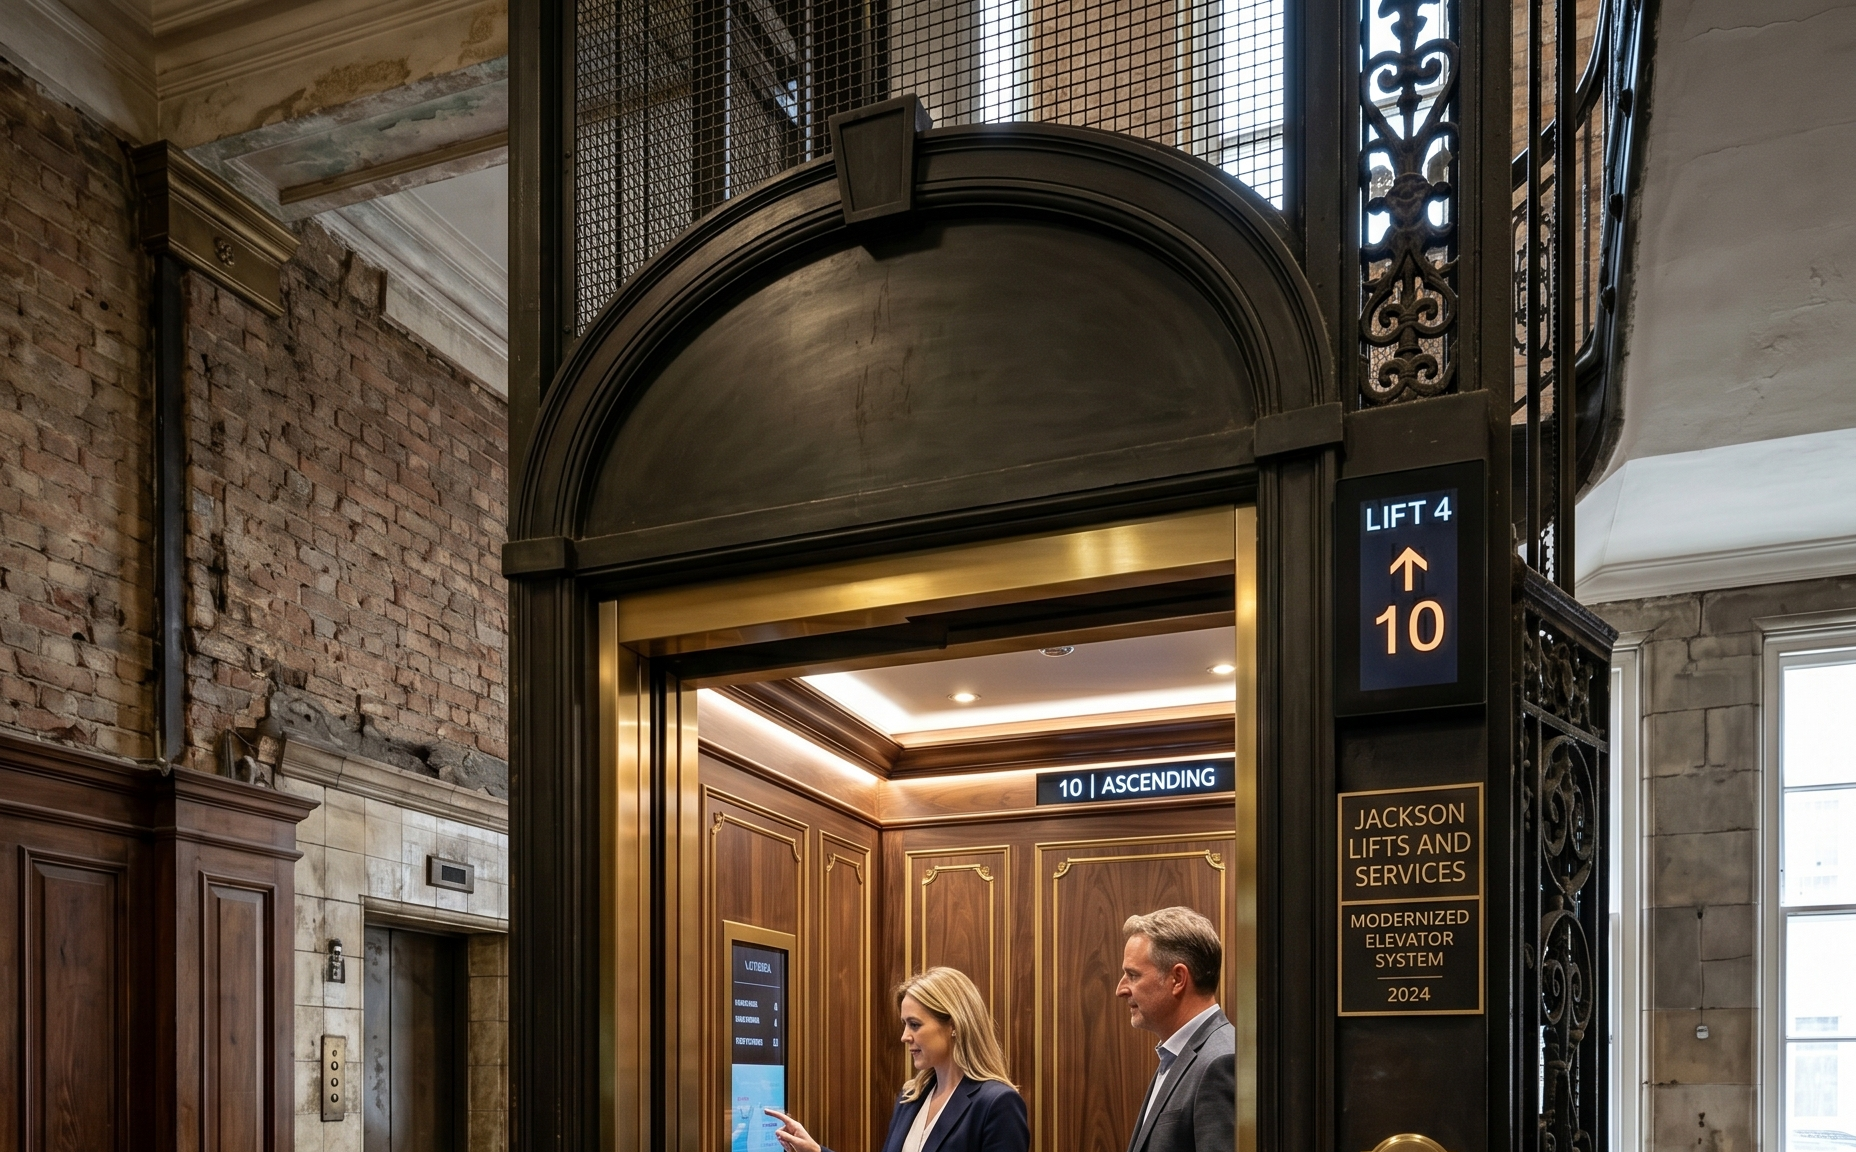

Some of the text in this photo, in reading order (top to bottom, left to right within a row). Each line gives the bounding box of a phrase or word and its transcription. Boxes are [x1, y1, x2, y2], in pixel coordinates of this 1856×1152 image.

[1366, 496, 1454, 532] LIFT 4
[1375, 600, 1445, 655] 10
[1058, 777, 1084, 798] 10
[1101, 767, 1216, 795] ASCENDING
[1354, 802, 1465, 830] JACKSON
[1349, 831, 1471, 859] LIFTS AND
[1355, 860, 1466, 888] SERVICES
[1350, 909, 1470, 929] MODERNIZED
[1365, 931, 1454, 948] ELEVATOR
[1375, 951, 1444, 968] SYSTEM
[1387, 986, 1431, 1002] 2024
